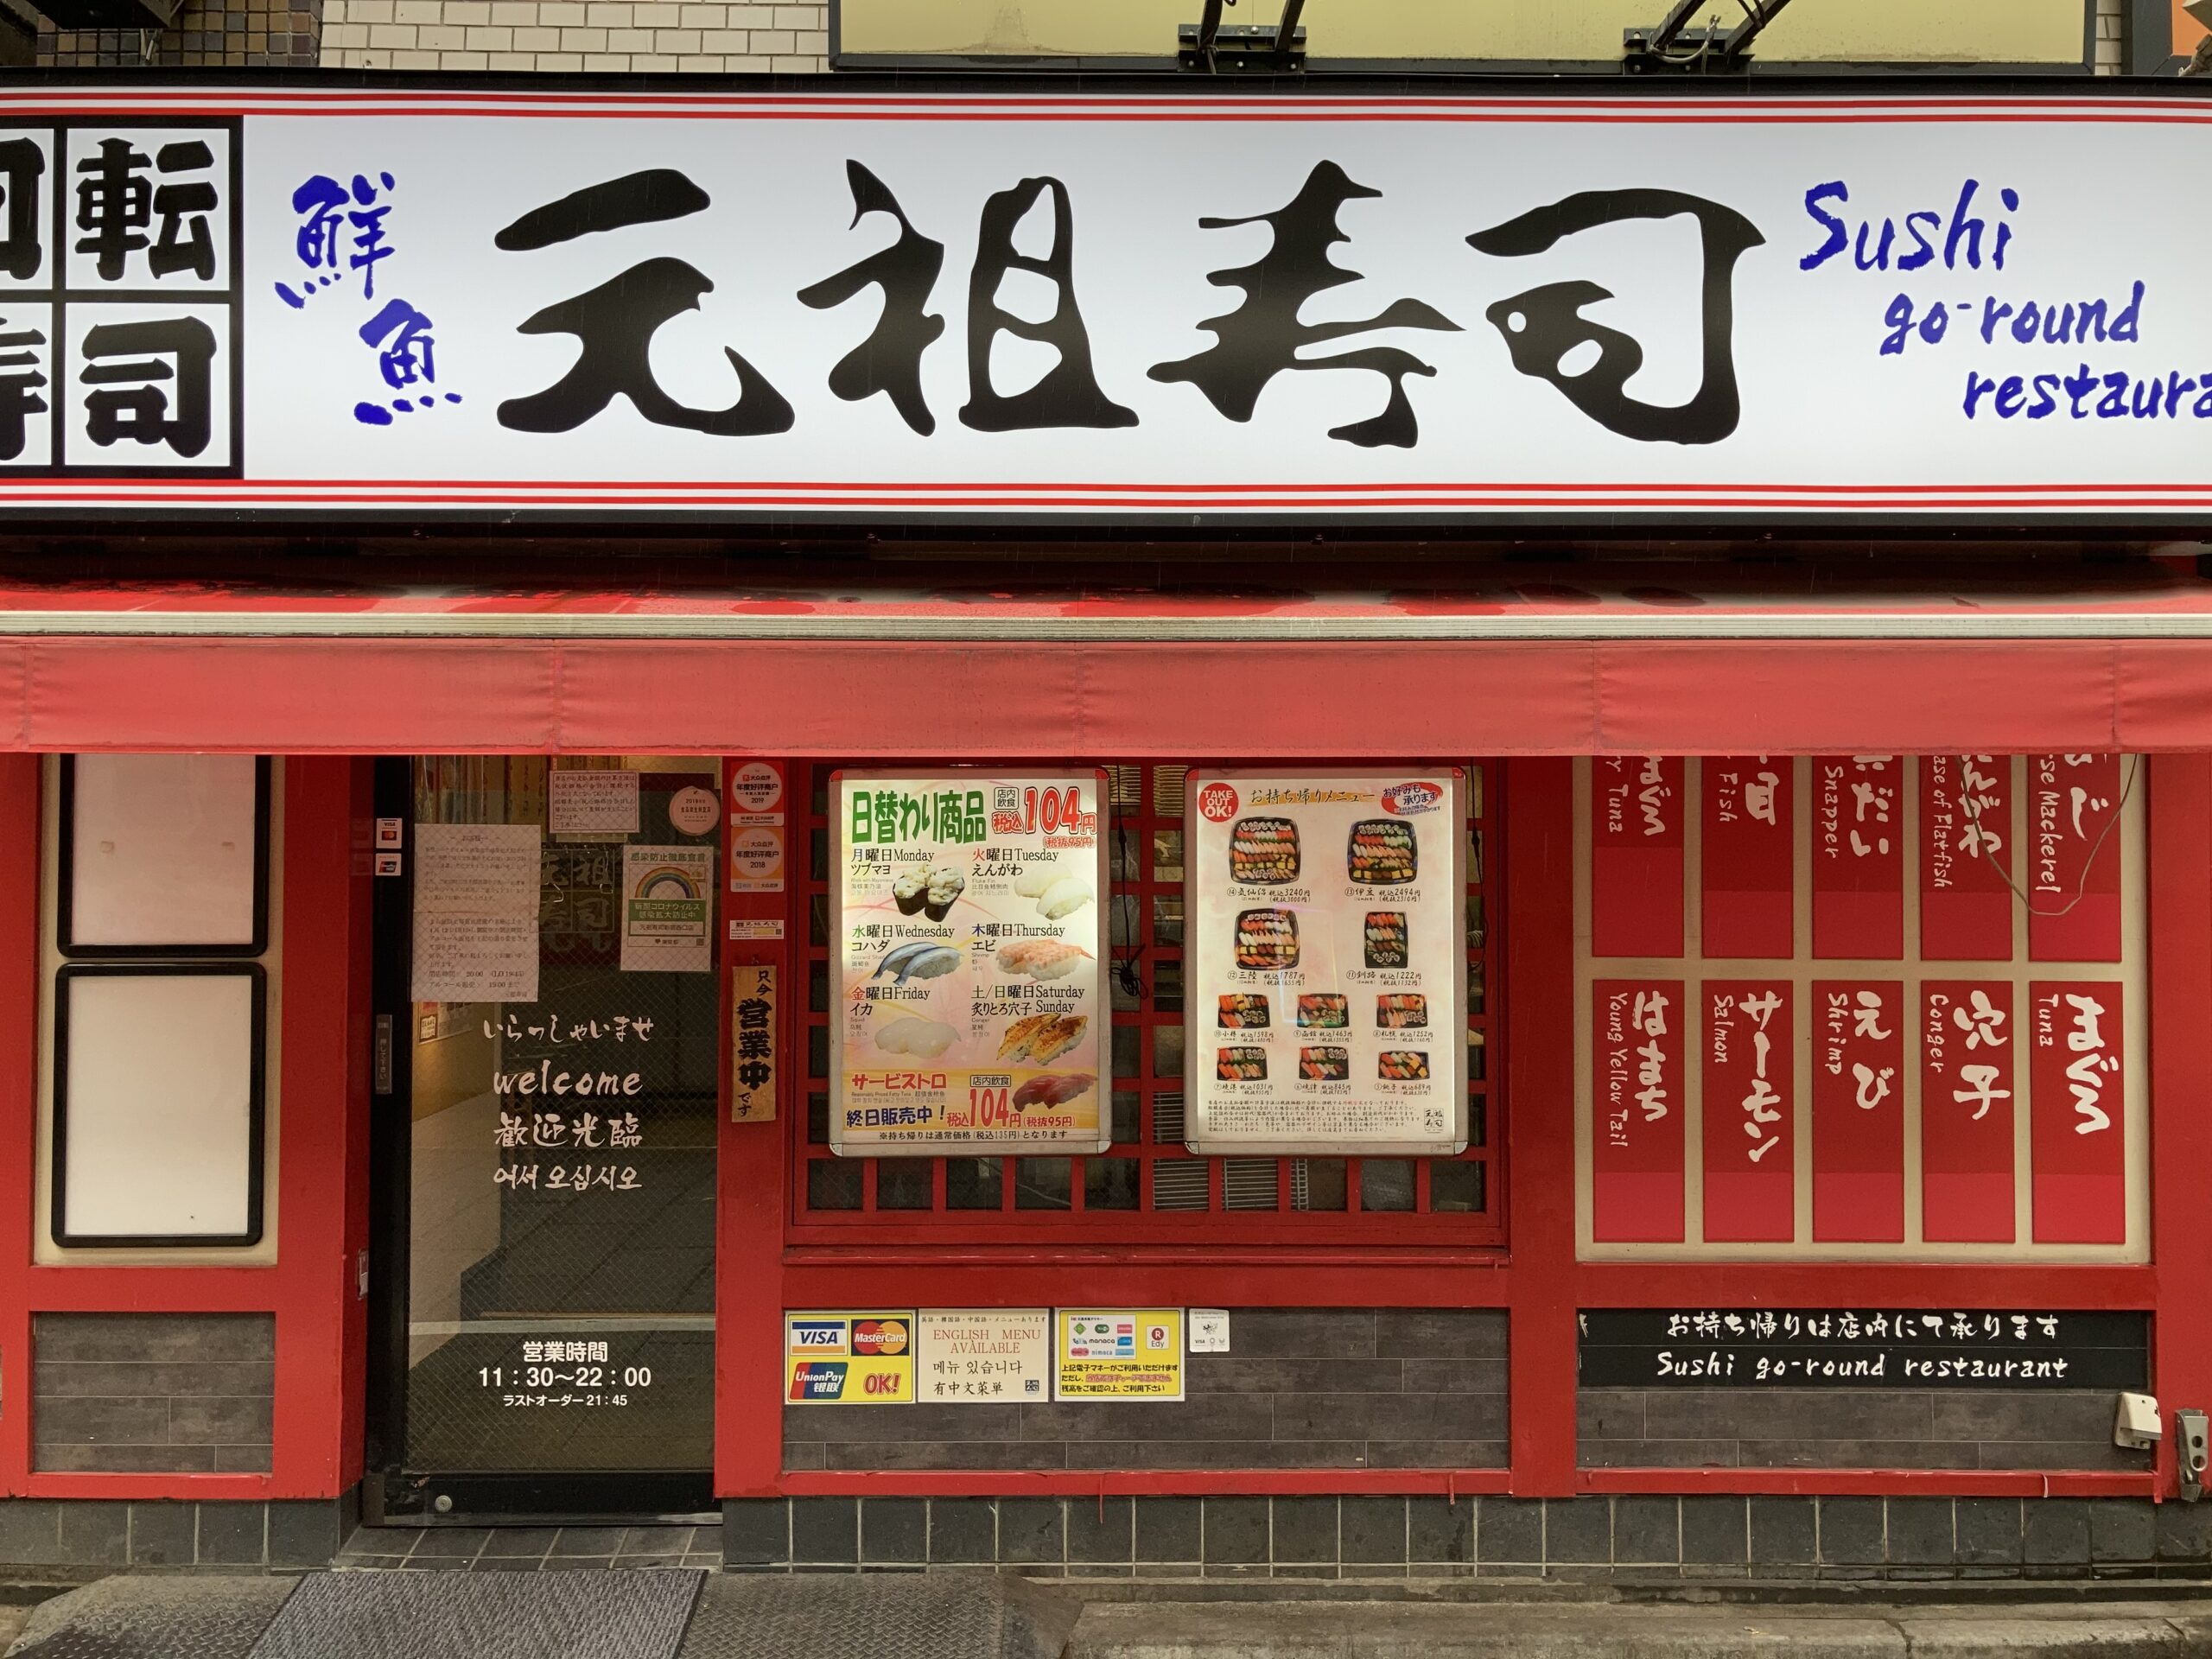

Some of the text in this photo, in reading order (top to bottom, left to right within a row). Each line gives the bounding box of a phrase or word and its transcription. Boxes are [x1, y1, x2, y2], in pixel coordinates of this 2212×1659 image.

[1800, 179, 2019, 271] Sushi
[276, 171, 463, 425] 鮮魚
[495, 158, 1766, 448] 元祖寿司
[1879, 280, 2145, 355] go-round
[996, 789, 1016, 798] 店内
[996, 798, 1016, 808] 飲食
[1204, 790, 1234, 798] TAKE
[1250, 788, 1376, 805] お持ち帰りメニュー
[1383, 784, 1421, 798] お好みも
[1403, 791, 1437, 805] 承ります
[1719, 772, 1738, 822] Fish
[1933, 789, 1953, 810] of
[851, 789, 987, 844] 日替わり商品
[1204, 805, 1232, 817] OK!
[1608, 784, 1629, 833] Tuna
[1821, 765, 1845, 859] Snapper
[1850, 755, 1893, 857] だい
[1957, 754, 2003, 859] んがわ
[2035, 791, 2064, 893] Mackerel
[851, 863, 892, 876] ツブマヨ
[971, 863, 1023, 877] えんがわ
[851, 939, 891, 953] コハダ
[971, 938, 996, 952] エビ
[756, 969, 773, 996] 只今
[849, 1002, 873, 1016] イカ
[970, 1000, 1075, 1016] 炙りとろ穴子 Sunday
[2037, 994, 2060, 1047] Tuna
[483, 1014, 654, 1043] いらっしゃいませ
[1713, 995, 1734, 1064] Salmon
[1824, 993, 1849, 1075] Shrimp
[1926, 994, 1949, 1073] Conger
[737, 997, 772, 1091] 営業中
[1631, 990, 1669, 1122] はまち
[1853, 990, 1895, 1110] えび
[1953, 989, 2012, 1121] 穴子
[493, 1059, 644, 1096] welcome
[1607, 992, 1629, 1147] Young Yellow Tail
[1738, 990, 1783, 1163] サーモン
[2065, 993, 2120, 1135] まぐろ
[851, 1072, 948, 1090] サービストロ
[972, 1076, 1010, 1086] 店内飲食
[737, 1091, 753, 1117] です
[493, 1164, 643, 1192] 어서 오십시오
[799, 1331, 906, 1344] VISA MasterCard
[933, 1329, 1041, 1340] ENGLISH MENU
[1667, 1311, 2059, 1340] お持ち帰りは店内にて承ります
[523, 1340, 608, 1363] 営業時間
[1150, 1340, 1165, 1349] Edy
[933, 1360, 1023, 1375] 메뉴 있습니다
[1061, 1363, 1179, 1372] 上記電子マネーがご利用いただけます
[1656, 1351, 2069, 1381] Sushi go-round restaurant
[795, 1370, 901, 1395] UnionPay OK!
